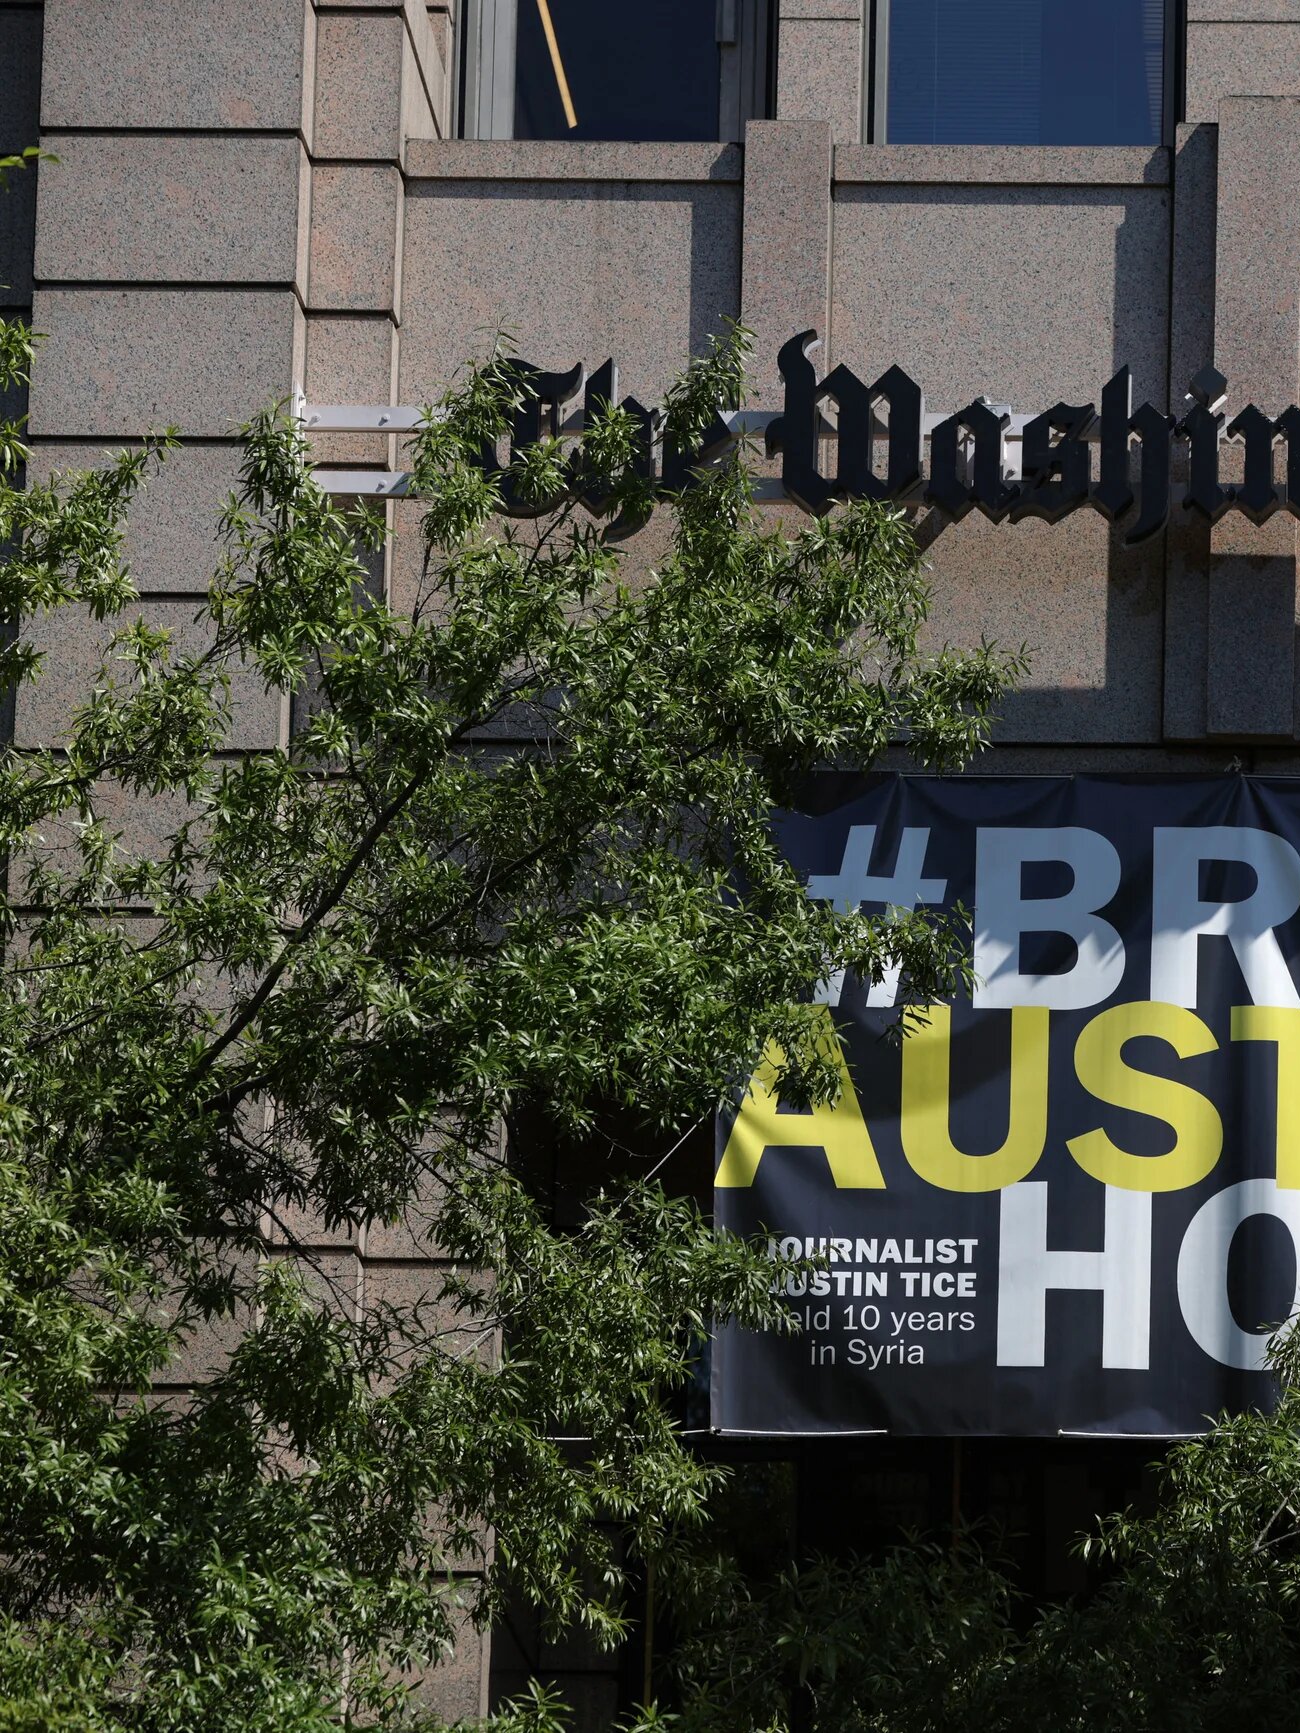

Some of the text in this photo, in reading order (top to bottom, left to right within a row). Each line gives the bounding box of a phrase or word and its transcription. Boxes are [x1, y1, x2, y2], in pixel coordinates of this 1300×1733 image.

[900, 1272, 977, 1298] TICE
[843, 1304, 880, 1331] 10
[890, 1311, 975, 1337] years
[810, 1338, 924, 1370] in Syria
